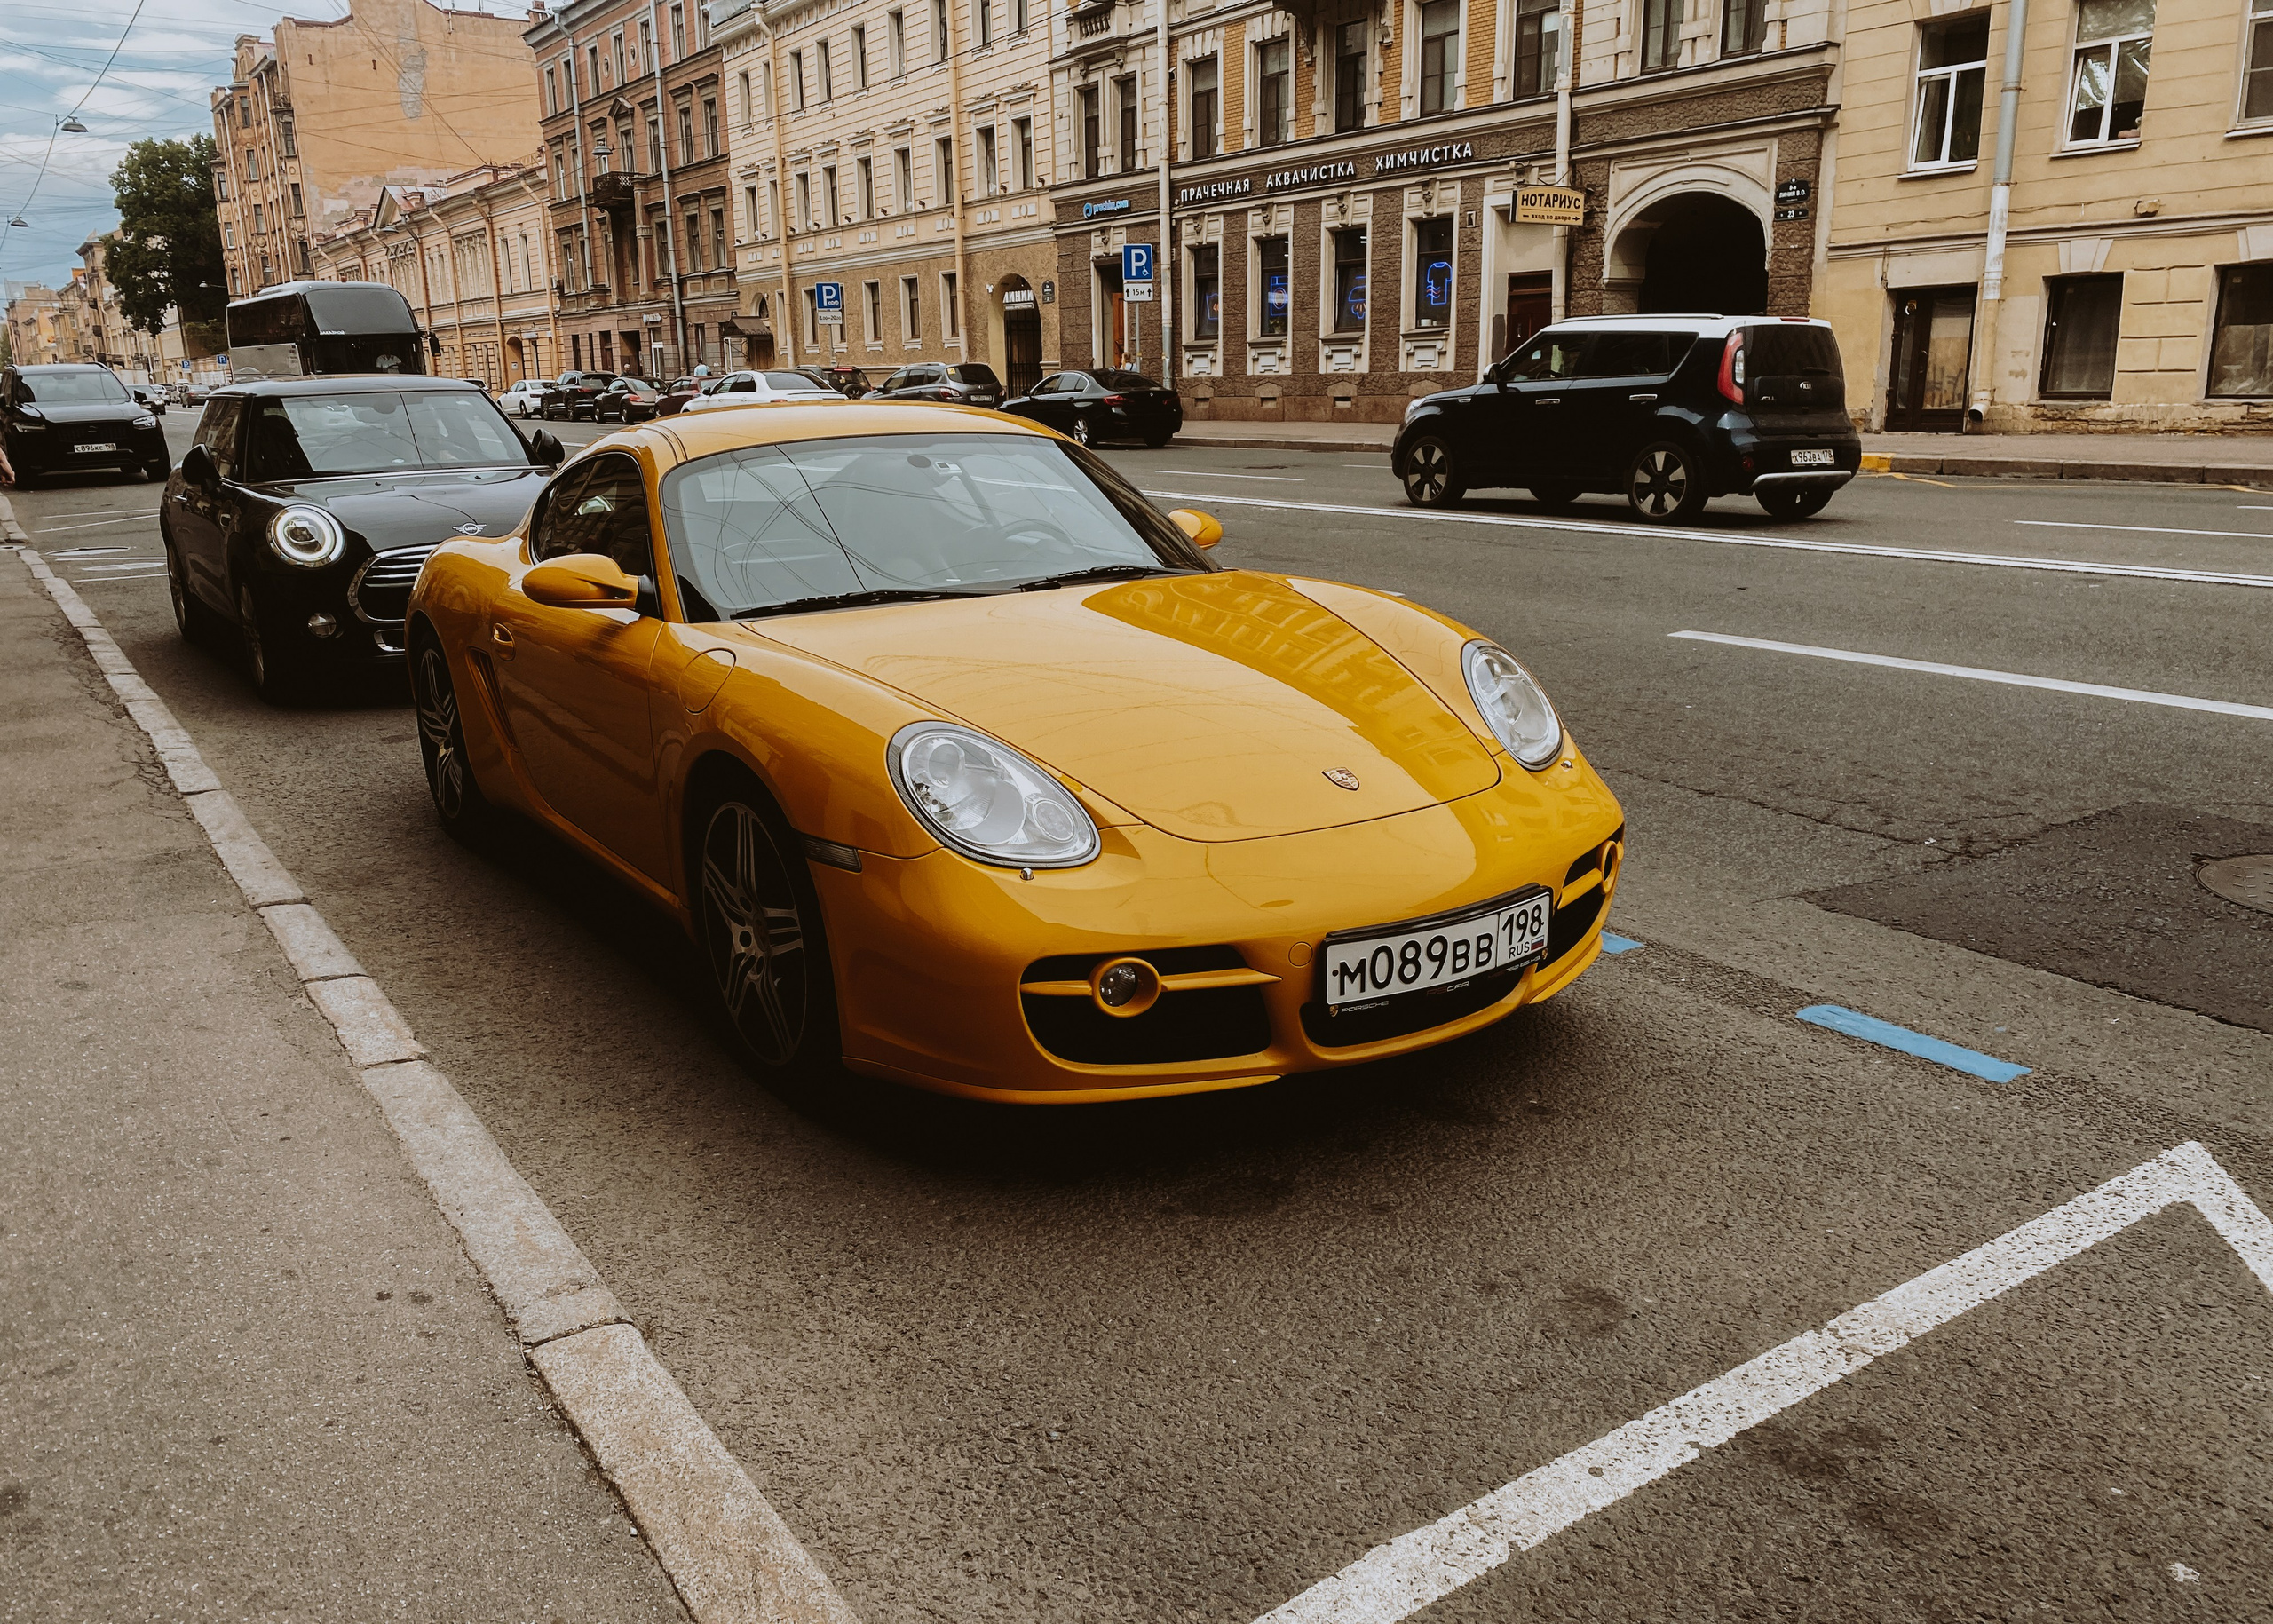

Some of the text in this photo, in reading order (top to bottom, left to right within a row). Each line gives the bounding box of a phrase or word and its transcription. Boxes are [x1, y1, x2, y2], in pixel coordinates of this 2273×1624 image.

[1181, 142, 1473, 202] ПРАЧЕЧНАЯ АКВАЧИСТКА ХИМЧИСТКА
[1521, 193, 1580, 209] НОТАРИУС
[1131, 249, 1147, 276] P
[822, 285, 836, 306] P
[1339, 904, 1542, 996] М089ВВ 198
[1509, 941, 1530, 959] RUS
[1341, 1001, 1390, 1013] PORSCHE
